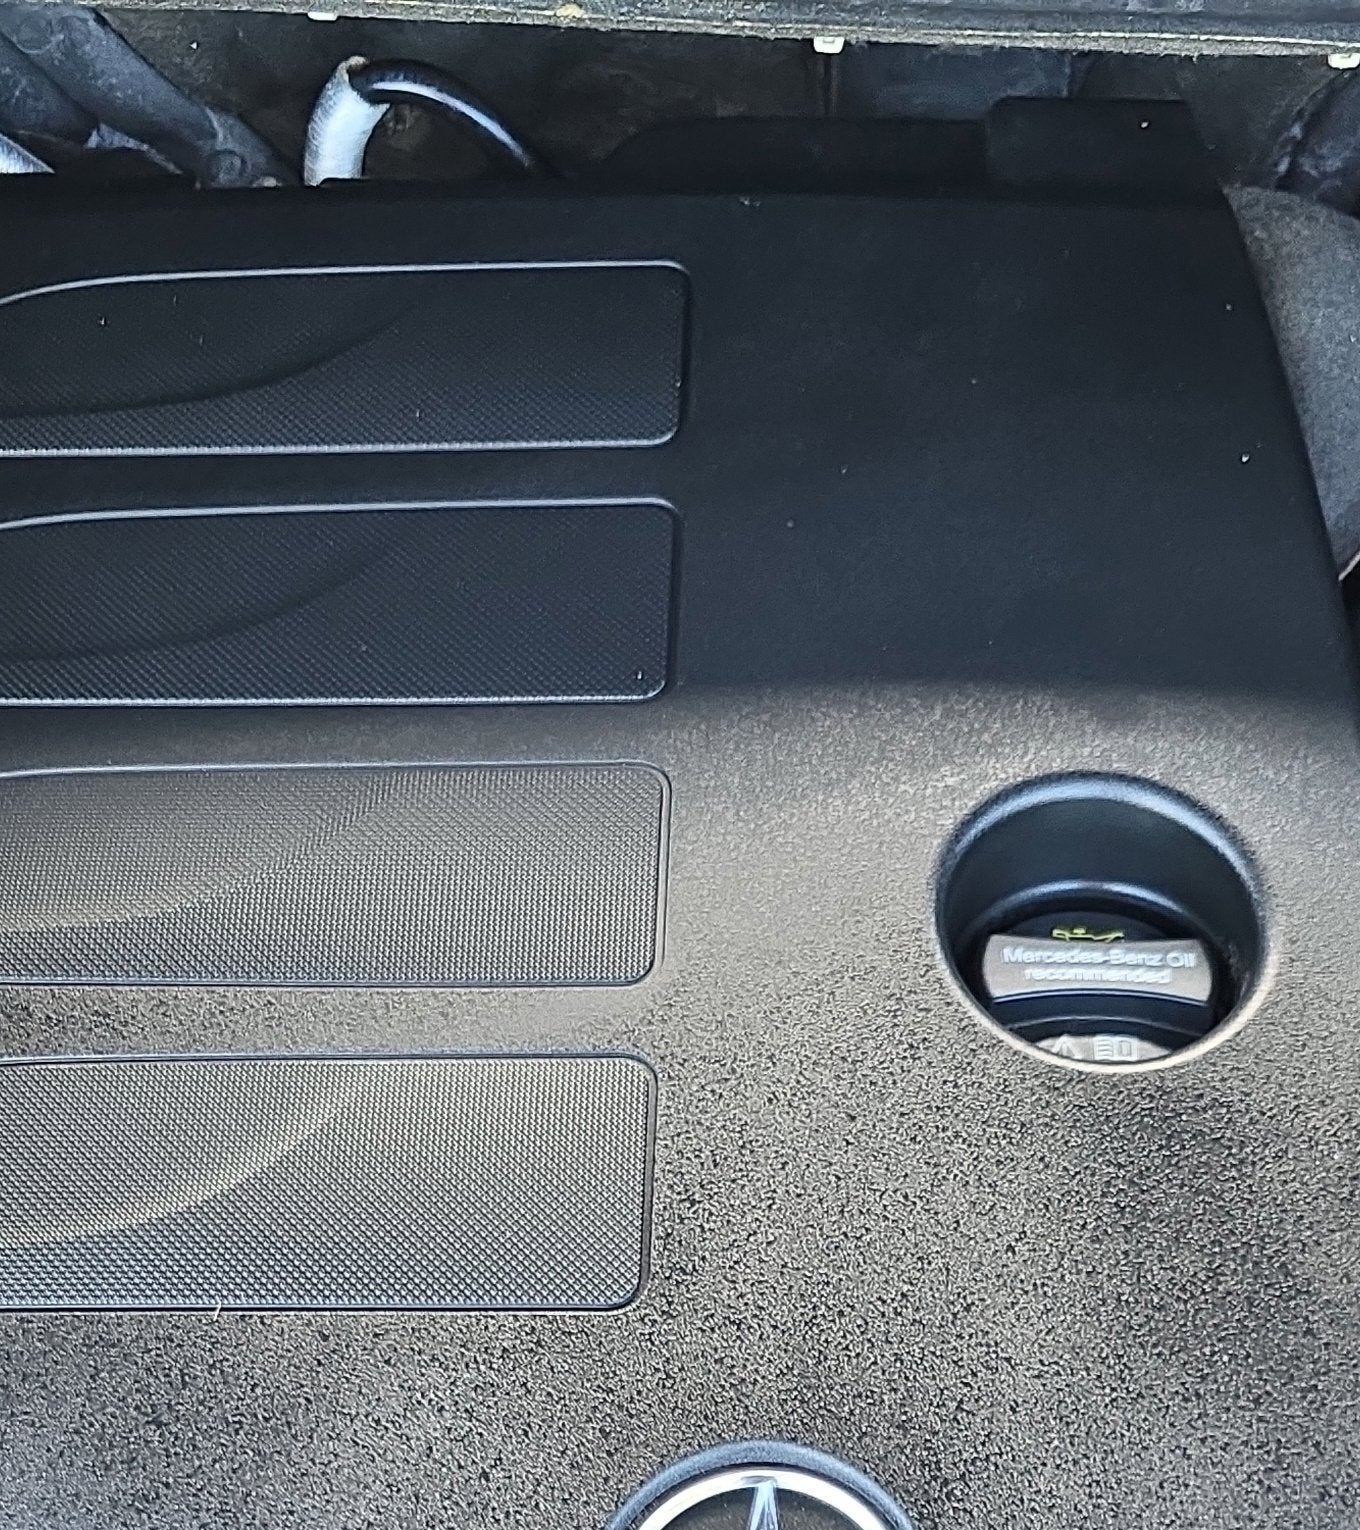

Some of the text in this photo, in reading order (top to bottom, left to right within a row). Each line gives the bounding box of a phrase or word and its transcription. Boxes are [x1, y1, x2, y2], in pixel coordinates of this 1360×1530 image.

[1002, 947, 1197, 968] Mercedes-Benz Oil
[1024, 968, 1173, 984] recommended
